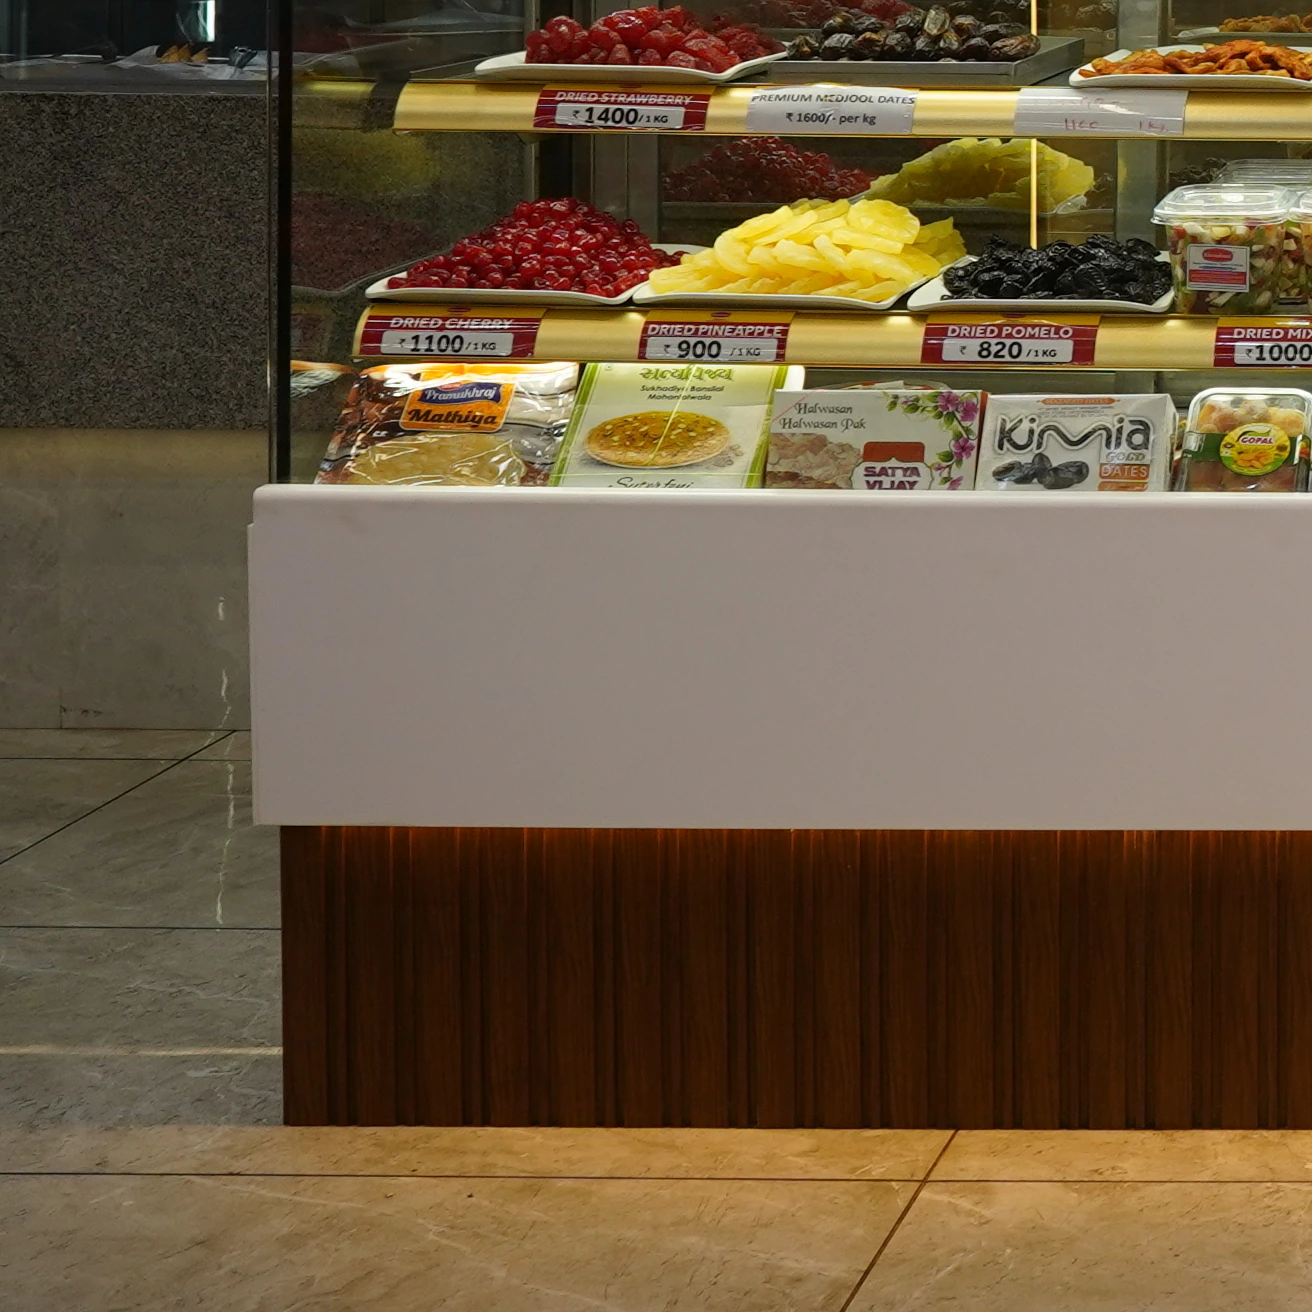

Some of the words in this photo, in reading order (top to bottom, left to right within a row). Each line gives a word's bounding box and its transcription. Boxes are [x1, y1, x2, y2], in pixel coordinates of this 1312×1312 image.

[555, 91, 599, 101] DRIED
[600, 92, 693, 105] STRAWBERRY
[752, 94, 814, 103] PREMIUM
[878, 95, 916, 105] DATES
[839, 115, 860, 125] per
[862, 114, 877, 126] kg
[390, 317, 443, 328] DRIED
[445, 318, 513, 330] CHERRY
[647, 323, 696, 335] DRIED
[698, 325, 783, 337] PINEAPPLE
[947, 326, 1000, 338] DRIED
[1001, 326, 1074, 338] POMELO
[1233, 328, 1286, 339] DRIED
[422, 384, 499, 404] Pramukhraj
[795, 401, 853, 415] Halwasan
[408, 408, 498, 427] Mathiya
[779, 416, 838, 430] Halwasan
[841, 416, 867, 432] Pak
[1240, 435, 1274, 445] GOPAL
[1105, 452, 1145, 462] GOLD
[863, 465, 921, 478] SATYA
[1100, 464, 1149, 478] DATES
